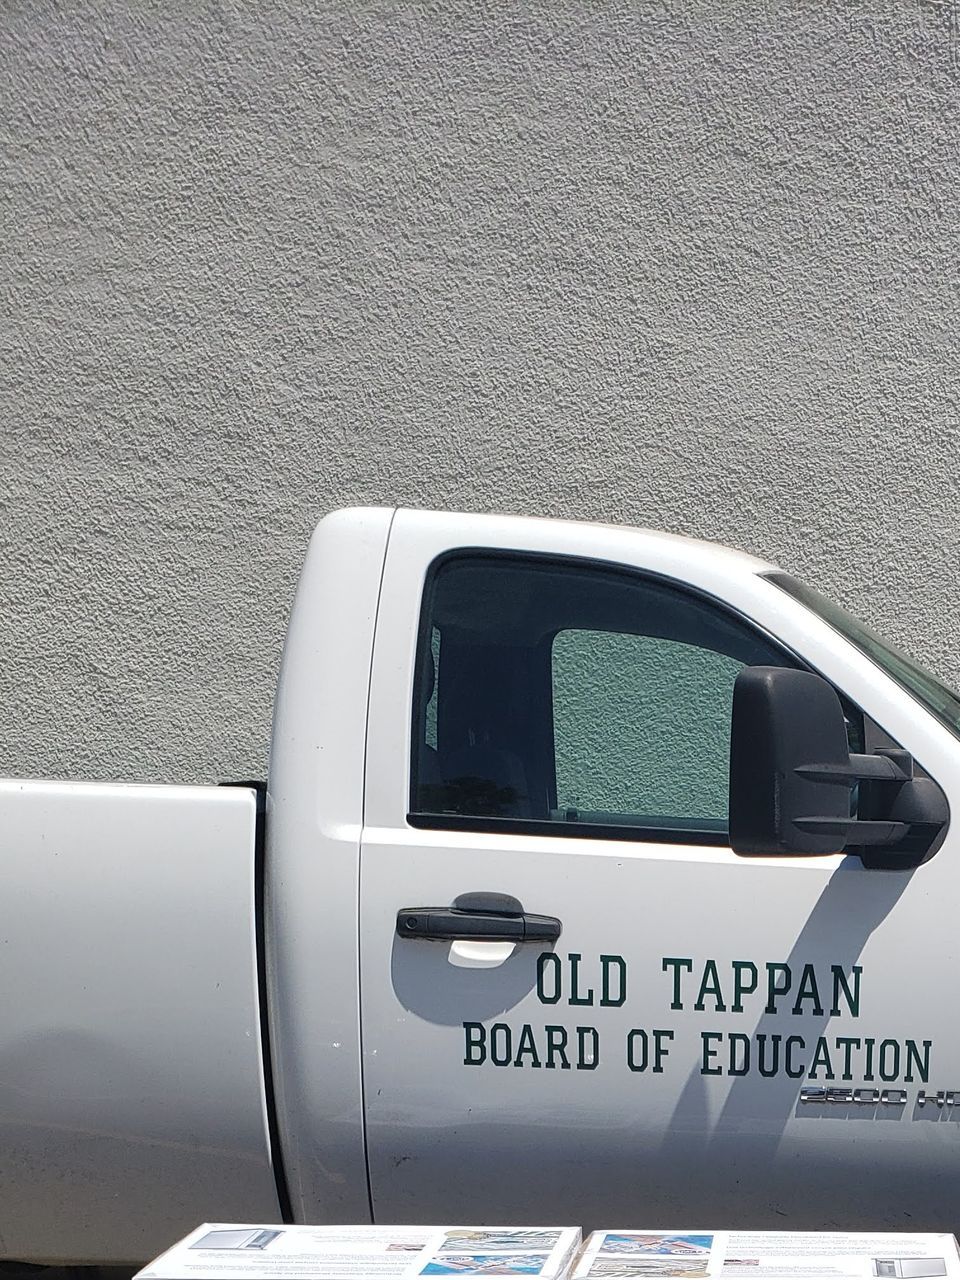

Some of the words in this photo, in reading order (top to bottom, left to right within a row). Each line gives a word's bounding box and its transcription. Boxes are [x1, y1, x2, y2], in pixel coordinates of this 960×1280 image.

[536, 952, 627, 1008] OLD
[662, 957, 863, 1018] TAPPAN
[462, 1021, 600, 1070] BOARD
[627, 1029, 674, 1073] OF
[700, 1031, 932, 1083] EDUCATION
